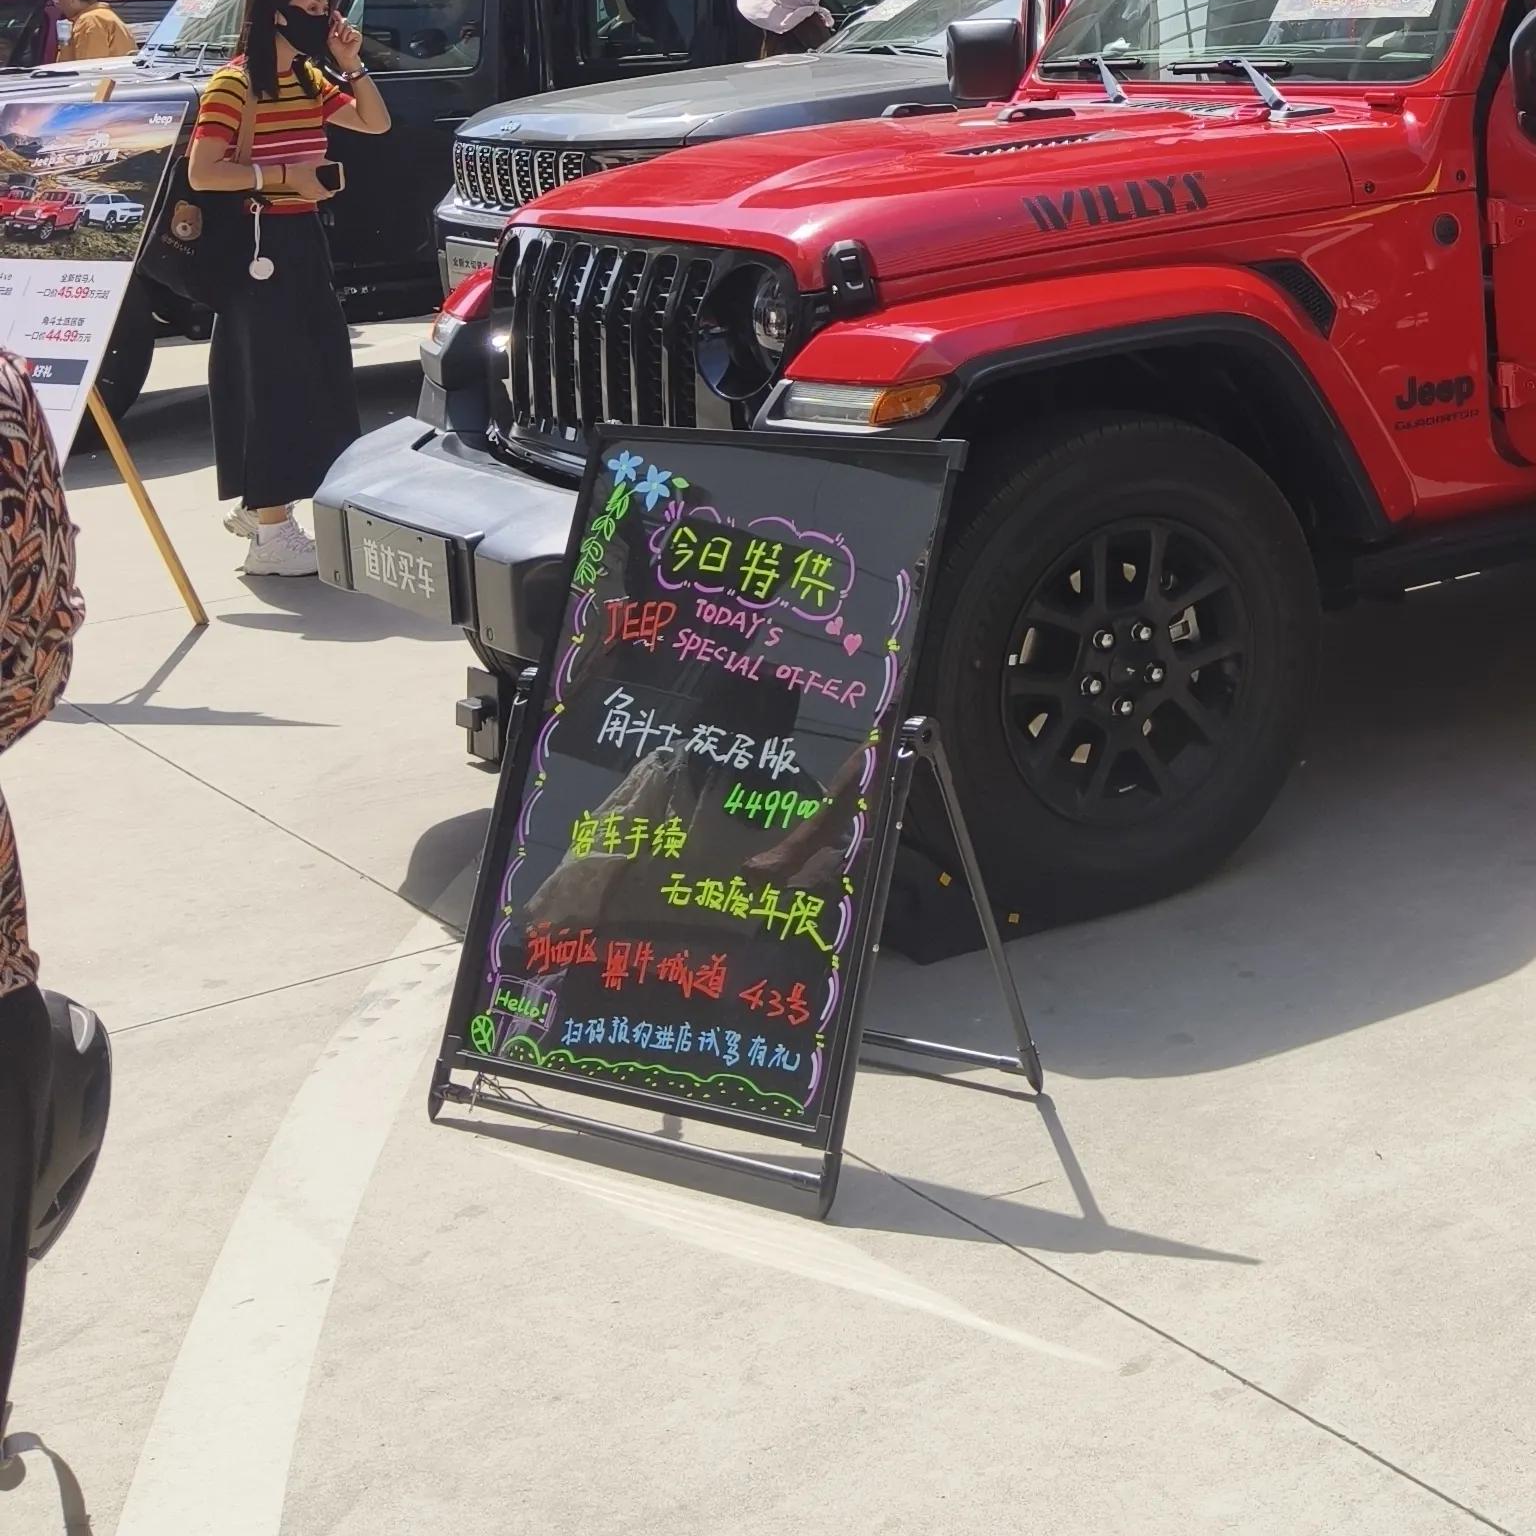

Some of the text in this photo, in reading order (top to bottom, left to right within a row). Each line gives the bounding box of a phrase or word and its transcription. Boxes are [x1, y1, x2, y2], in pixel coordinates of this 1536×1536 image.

[149, 113, 173, 125] Jeep
[1022, 172, 1208, 231] WILLYS
[1394, 375, 1475, 411] Jeep
[671, 526, 836, 608] 今日特供
[603, 600, 678, 653] JEEP
[671, 628, 867, 709] SPECIAL OFFER
[494, 987, 549, 1024] Hello!
